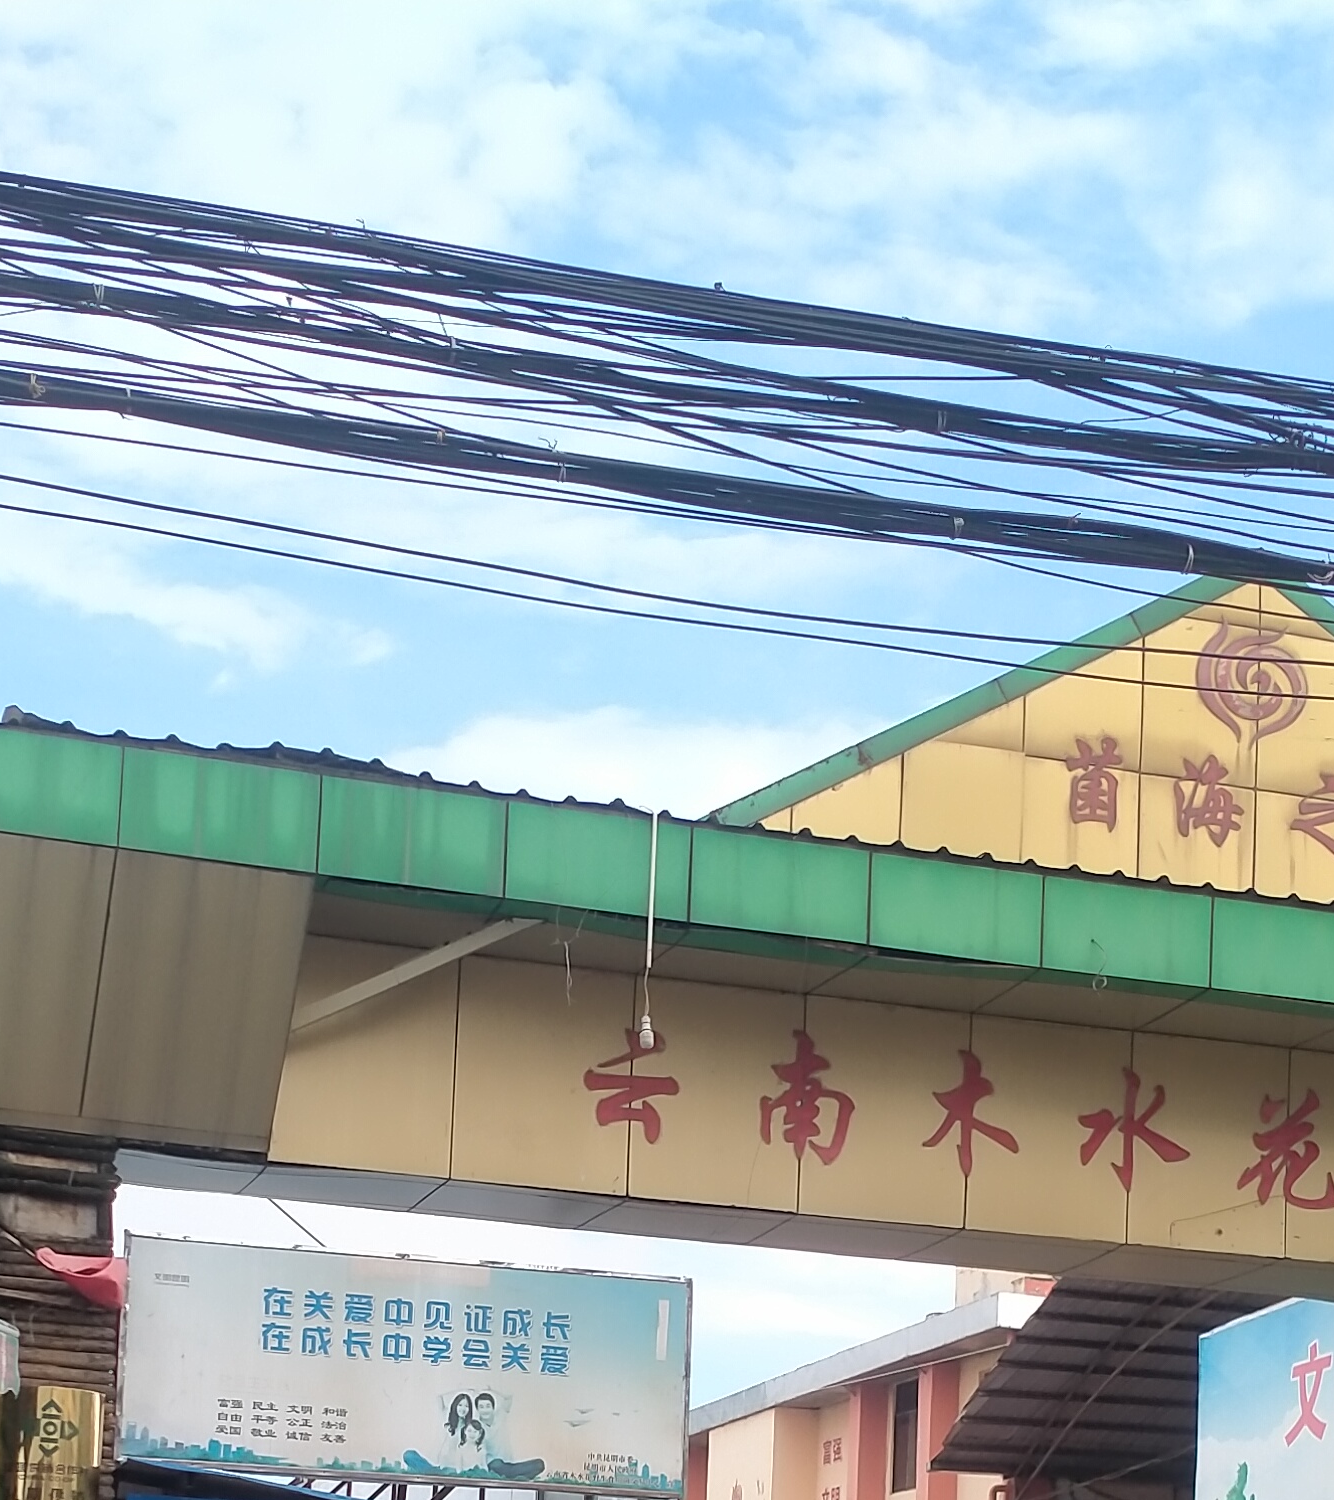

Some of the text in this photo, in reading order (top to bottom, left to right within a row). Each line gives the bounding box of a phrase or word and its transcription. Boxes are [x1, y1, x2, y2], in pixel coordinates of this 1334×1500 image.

[262, 1286, 572, 1341] 在关爱中见证成长
[260, 1322, 571, 1376] 在成长中学会关爱
[218, 1398, 348, 1417] 富强 民主 文明 和谐
[217, 1412, 347, 1431] 自由 平等 公正 法治
[215, 1425, 347, 1444] 爱国 敬业 诚信 友善
